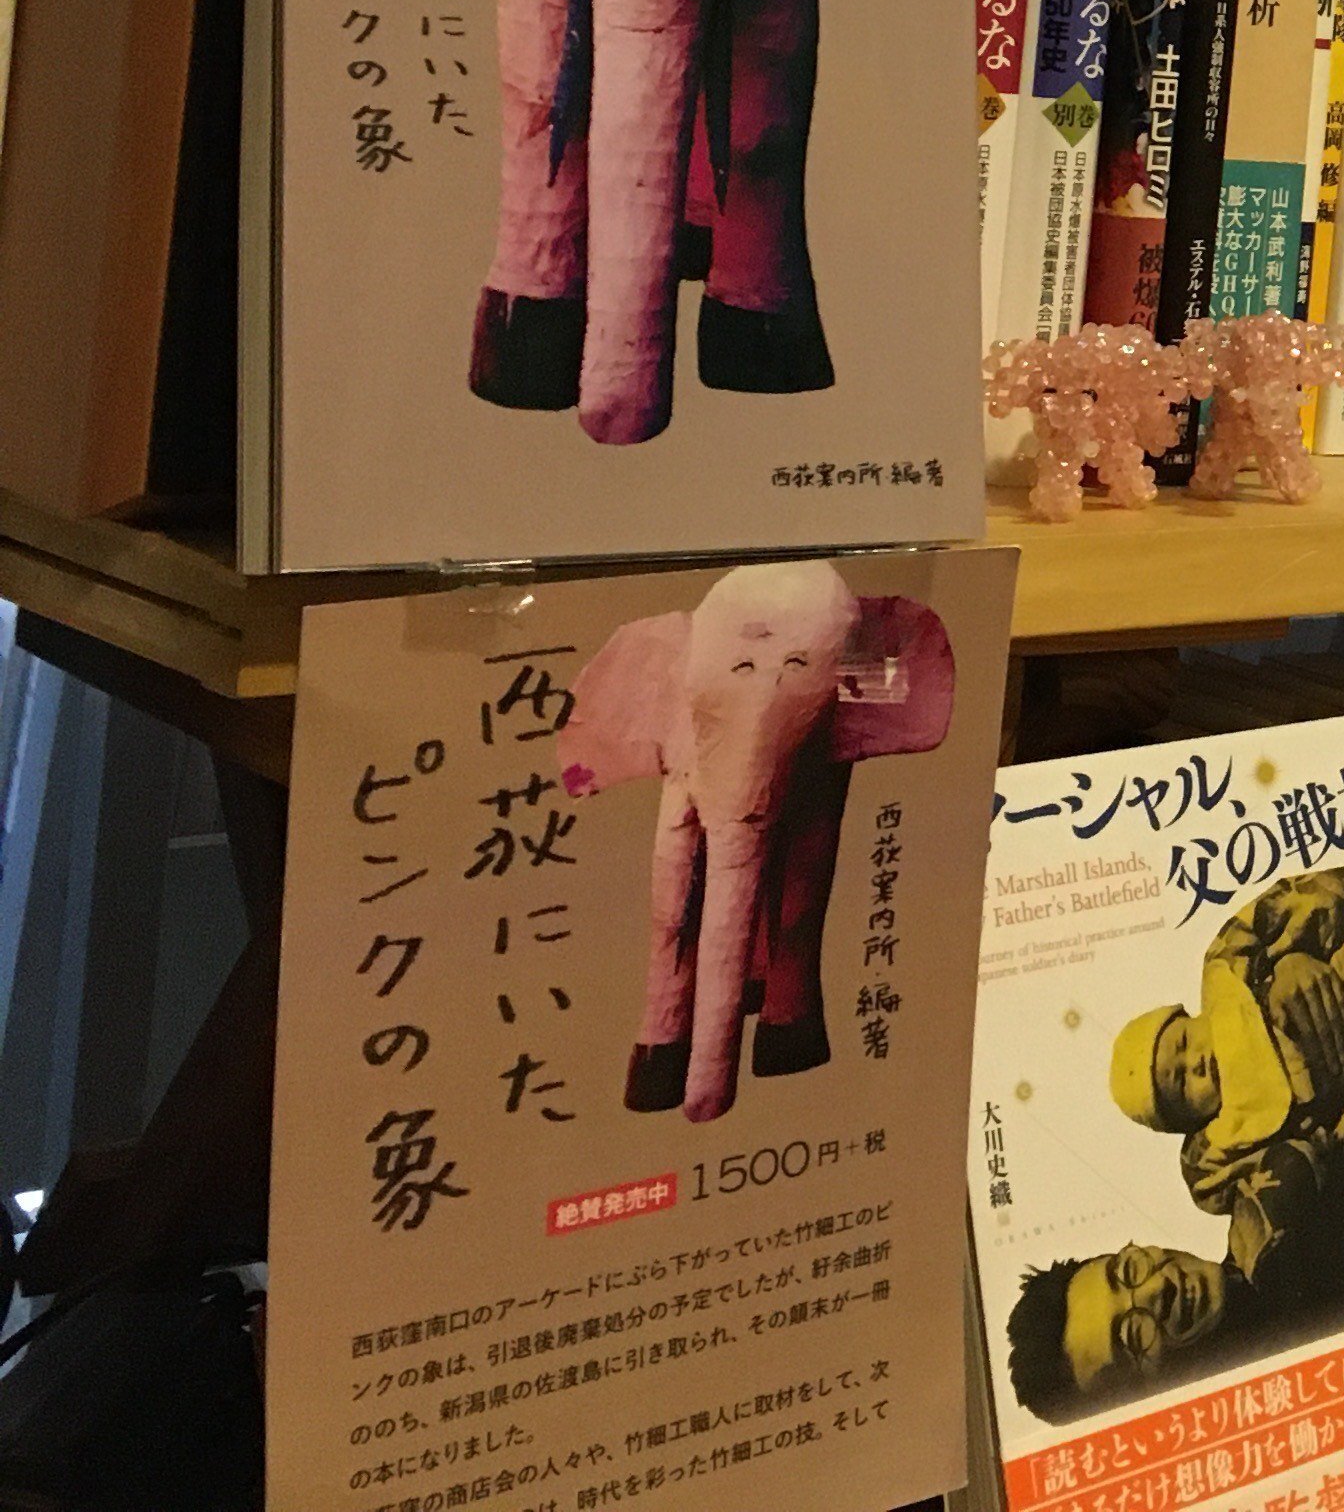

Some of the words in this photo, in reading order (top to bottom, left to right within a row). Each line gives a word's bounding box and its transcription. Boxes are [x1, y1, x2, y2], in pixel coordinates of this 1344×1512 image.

[1051, 100, 1097, 131] 別巻
[1144, 45, 1181, 209] 土田ヒロミ
[1262, 186, 1292, 308] 山本武利著
[993, 754, 1248, 840] ーシャル、
[464, 644, 577, 1124] 西荻にいた
[992, 894, 1067, 929] Father's
[1071, 875, 1162, 914] Battlefield
[994, 861, 1078, 898] Marshall
[1083, 850, 1153, 881] Islands,
[1018, 944, 1031, 958] of
[1031, 934, 1082, 956] historical
[1084, 928, 1126, 947] practice
[1128, 916, 1166, 936] around
[352, 740, 471, 1233] ピンクの象
[555, 1179, 671, 1230] 絶賛発売中
[980, 1101, 1014, 1211] 大川史織
[349, 1238, 894, 1404] ンクの象は、引退後廃棄処分の予定でしたが、紆余曲折
[350, 1199, 895, 1361] 西荻窪南口のアーケードにぶら下がっていた竹細工のピ
[349, 1424, 537, 1491] の本になりました。
